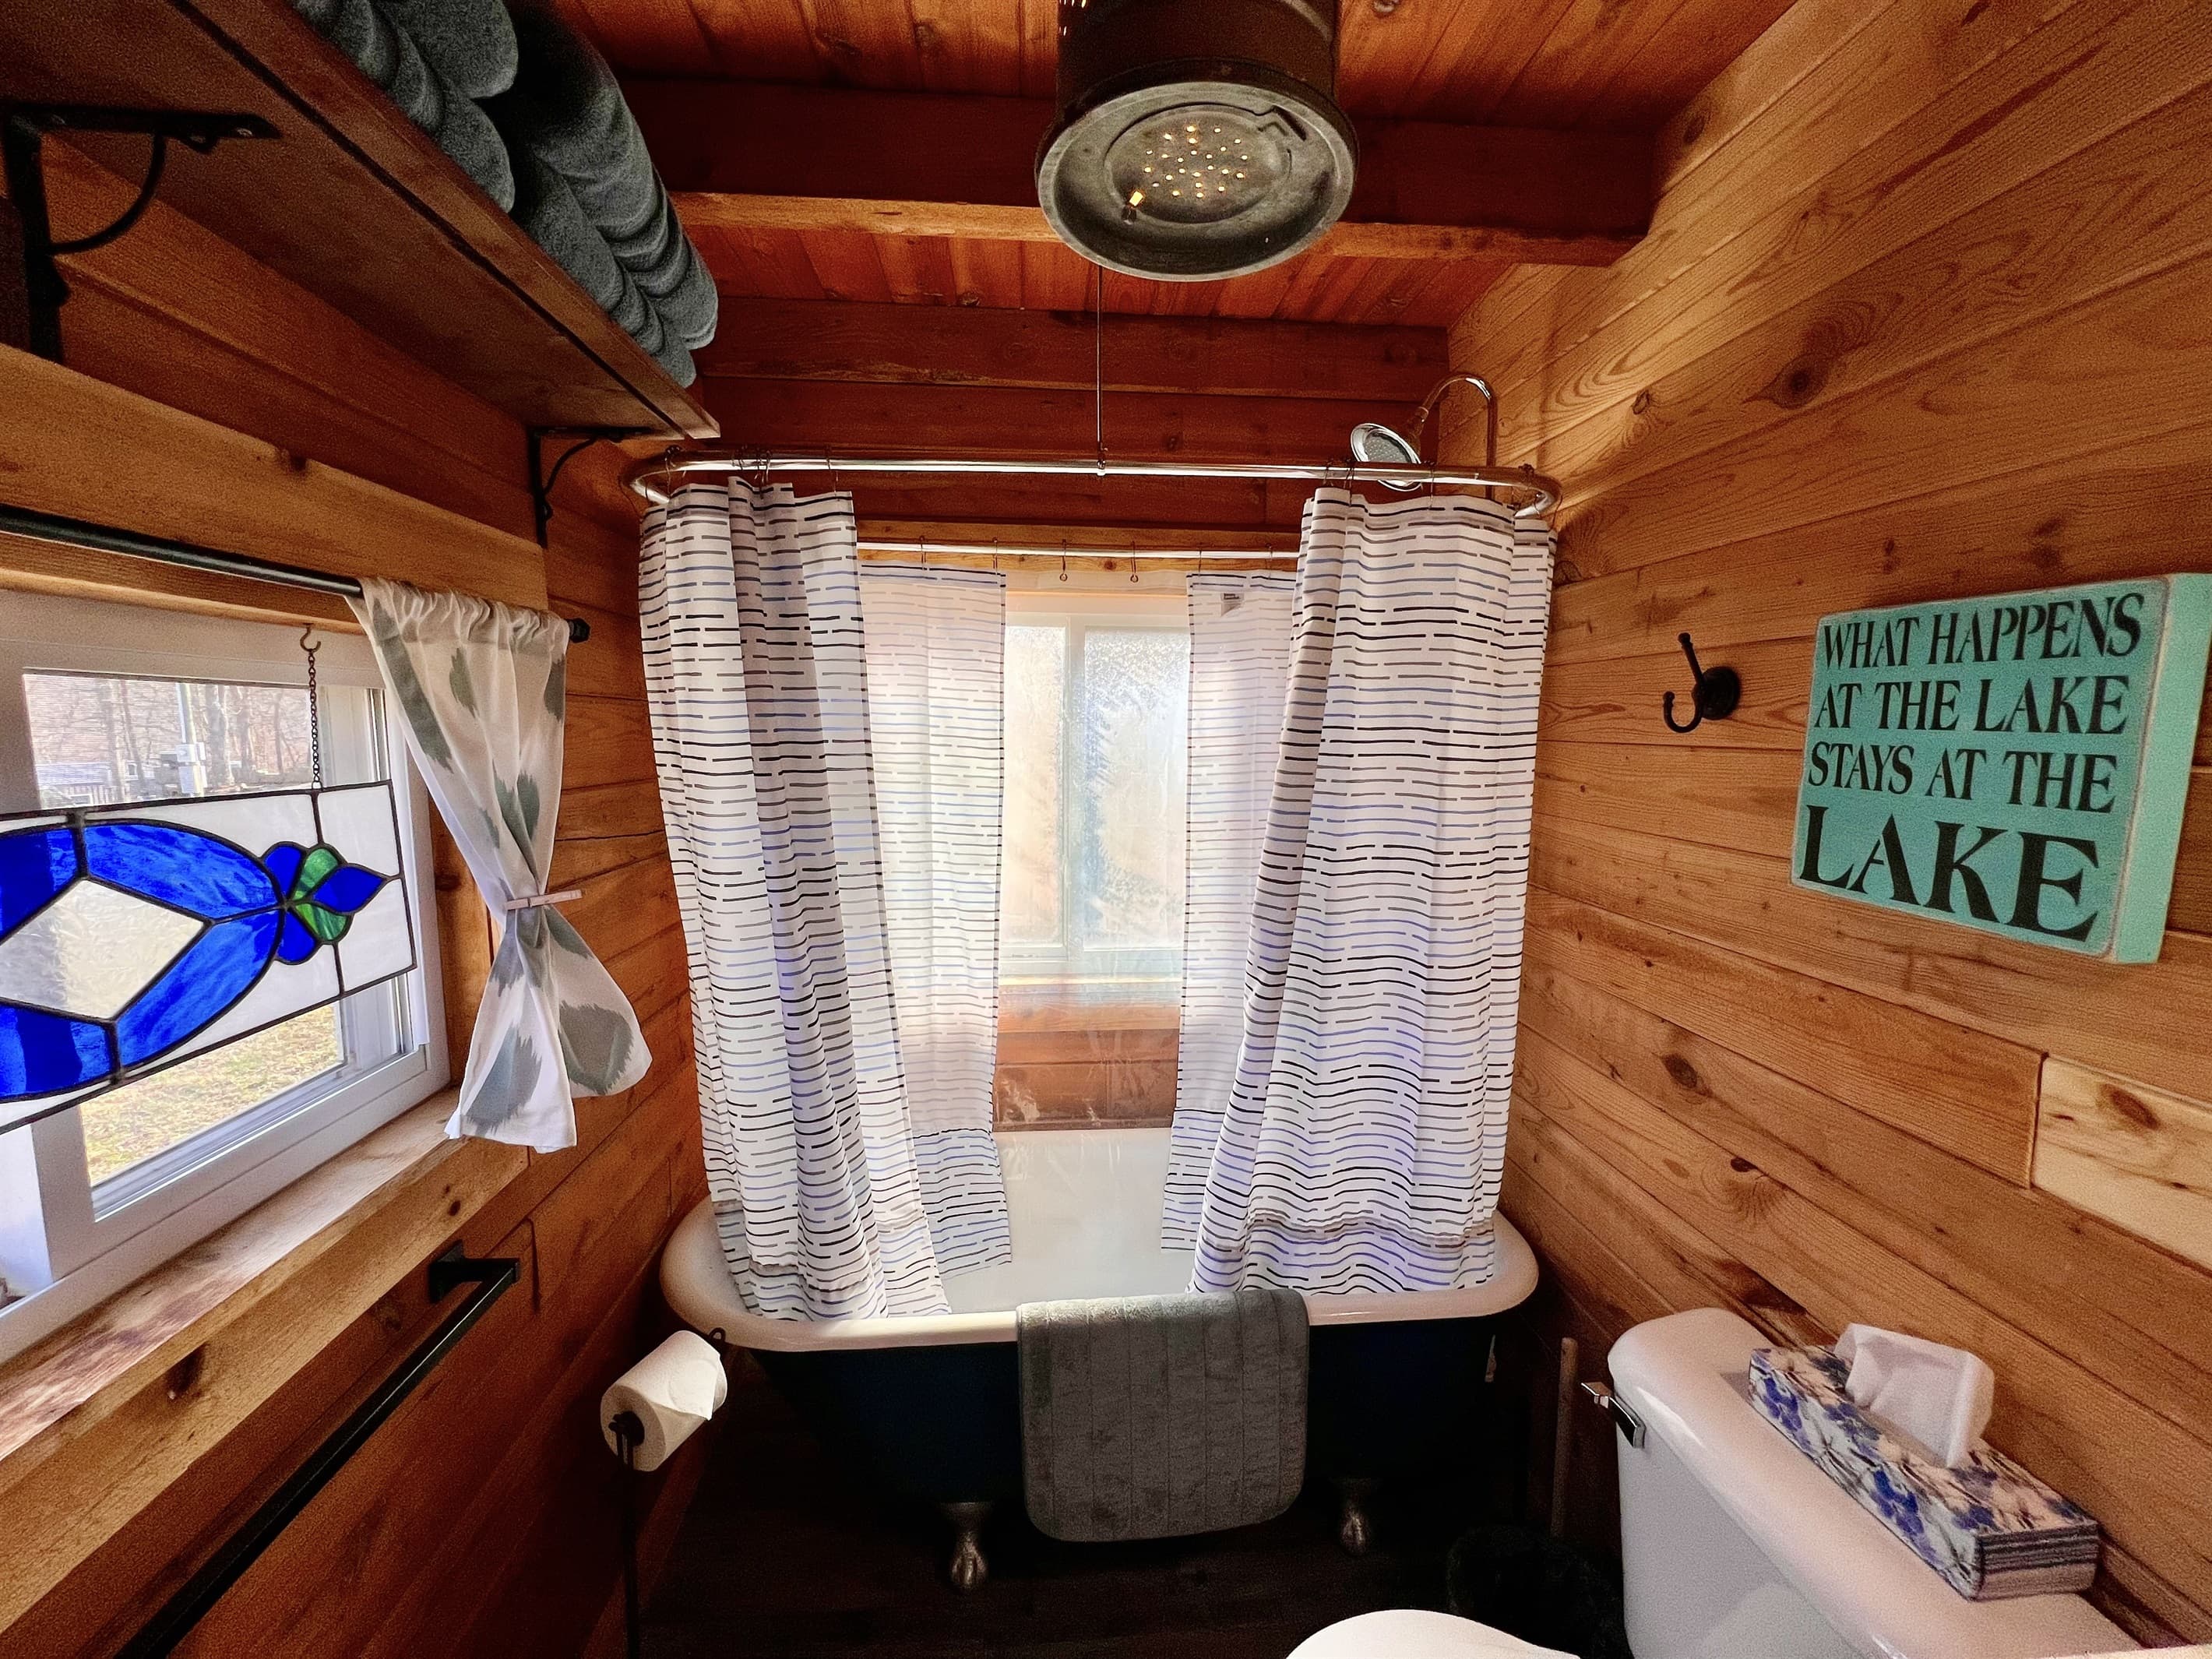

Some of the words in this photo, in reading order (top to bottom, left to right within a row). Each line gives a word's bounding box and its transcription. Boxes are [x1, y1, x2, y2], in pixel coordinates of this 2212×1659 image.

[1823, 616, 1919, 670] WHAT
[1928, 592, 2146, 665] HAPPENS
[1814, 683, 1862, 728] AT
[1874, 679, 1961, 731] THE
[1974, 675, 2130, 735] LAKE
[1808, 741, 1915, 794] STAYS
[1924, 747, 1987, 801] AT
[2001, 751, 2118, 814] THE
[1799, 805, 2099, 942] LAKE
